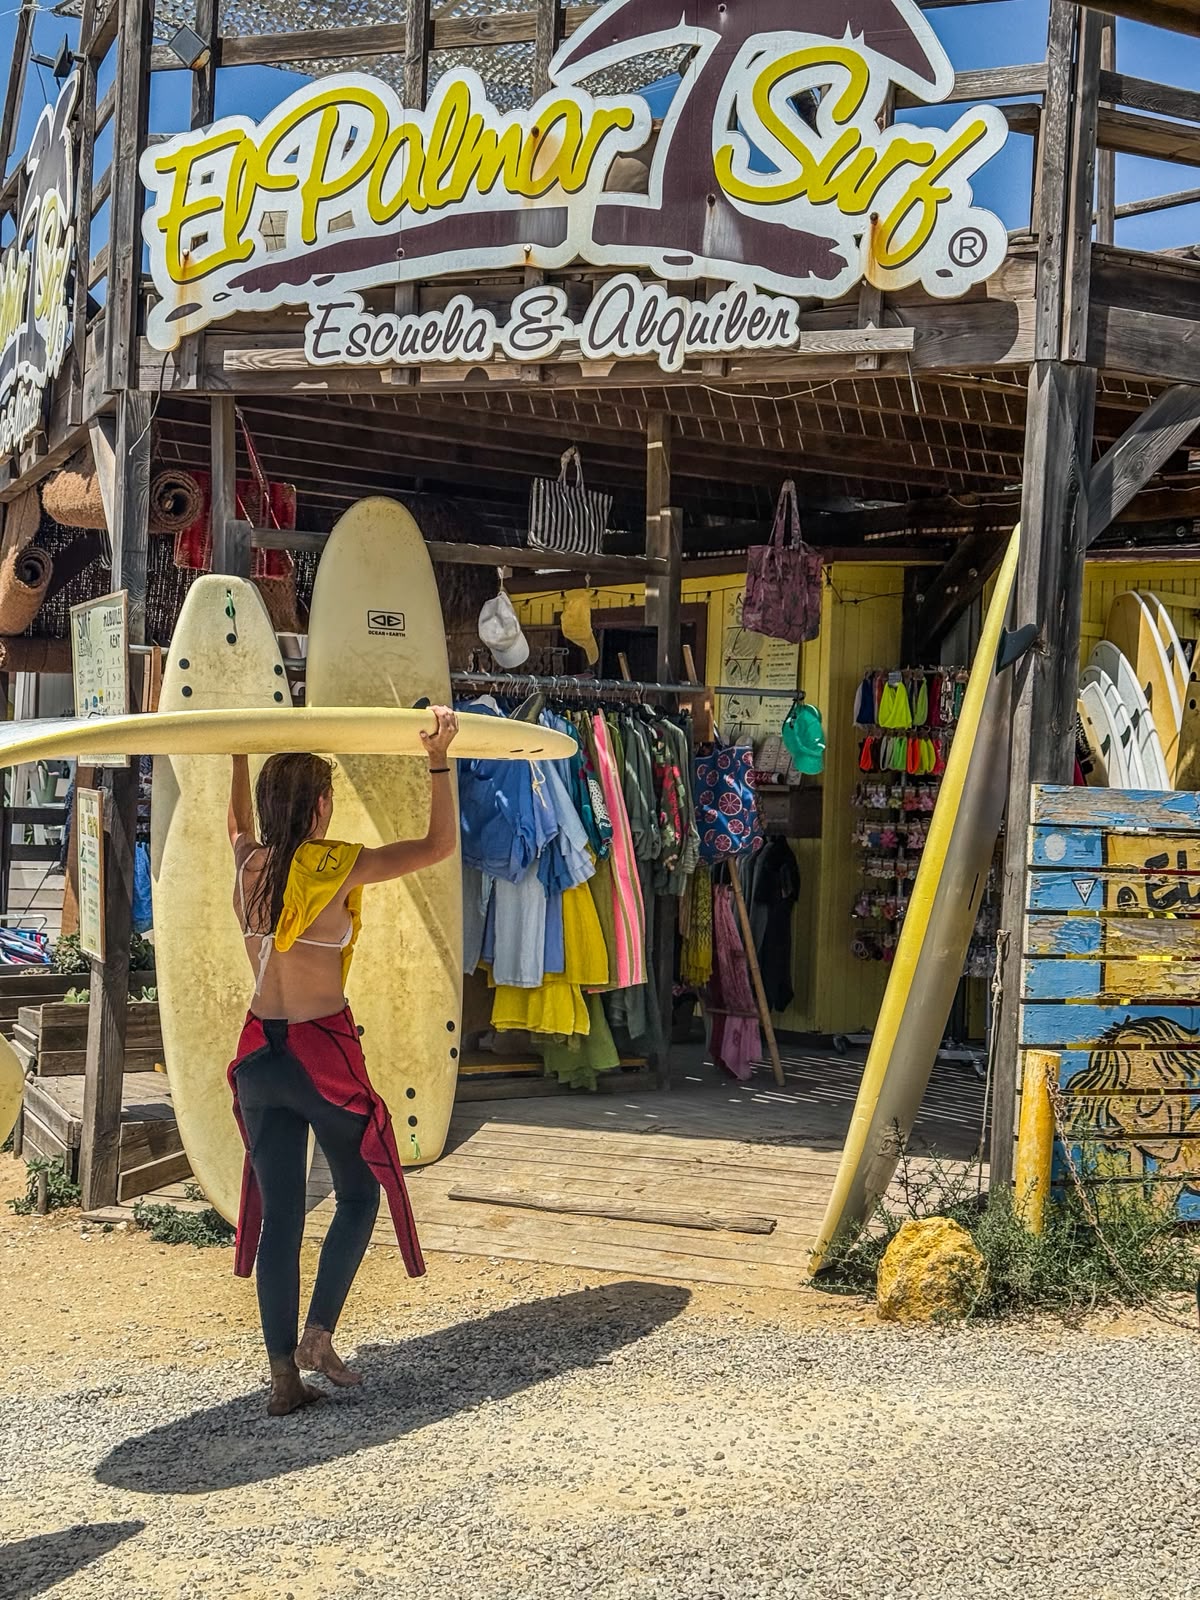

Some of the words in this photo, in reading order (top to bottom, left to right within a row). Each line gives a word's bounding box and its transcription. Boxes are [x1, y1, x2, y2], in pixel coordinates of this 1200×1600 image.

[155, 129, 256, 285] El
[258, 81, 635, 245] Palmar
[714, 45, 988, 270] Surf
[312, 299, 486, 359] Escuela
[509, 294, 567, 352] &
[588, 281, 791, 366] Alquiler
